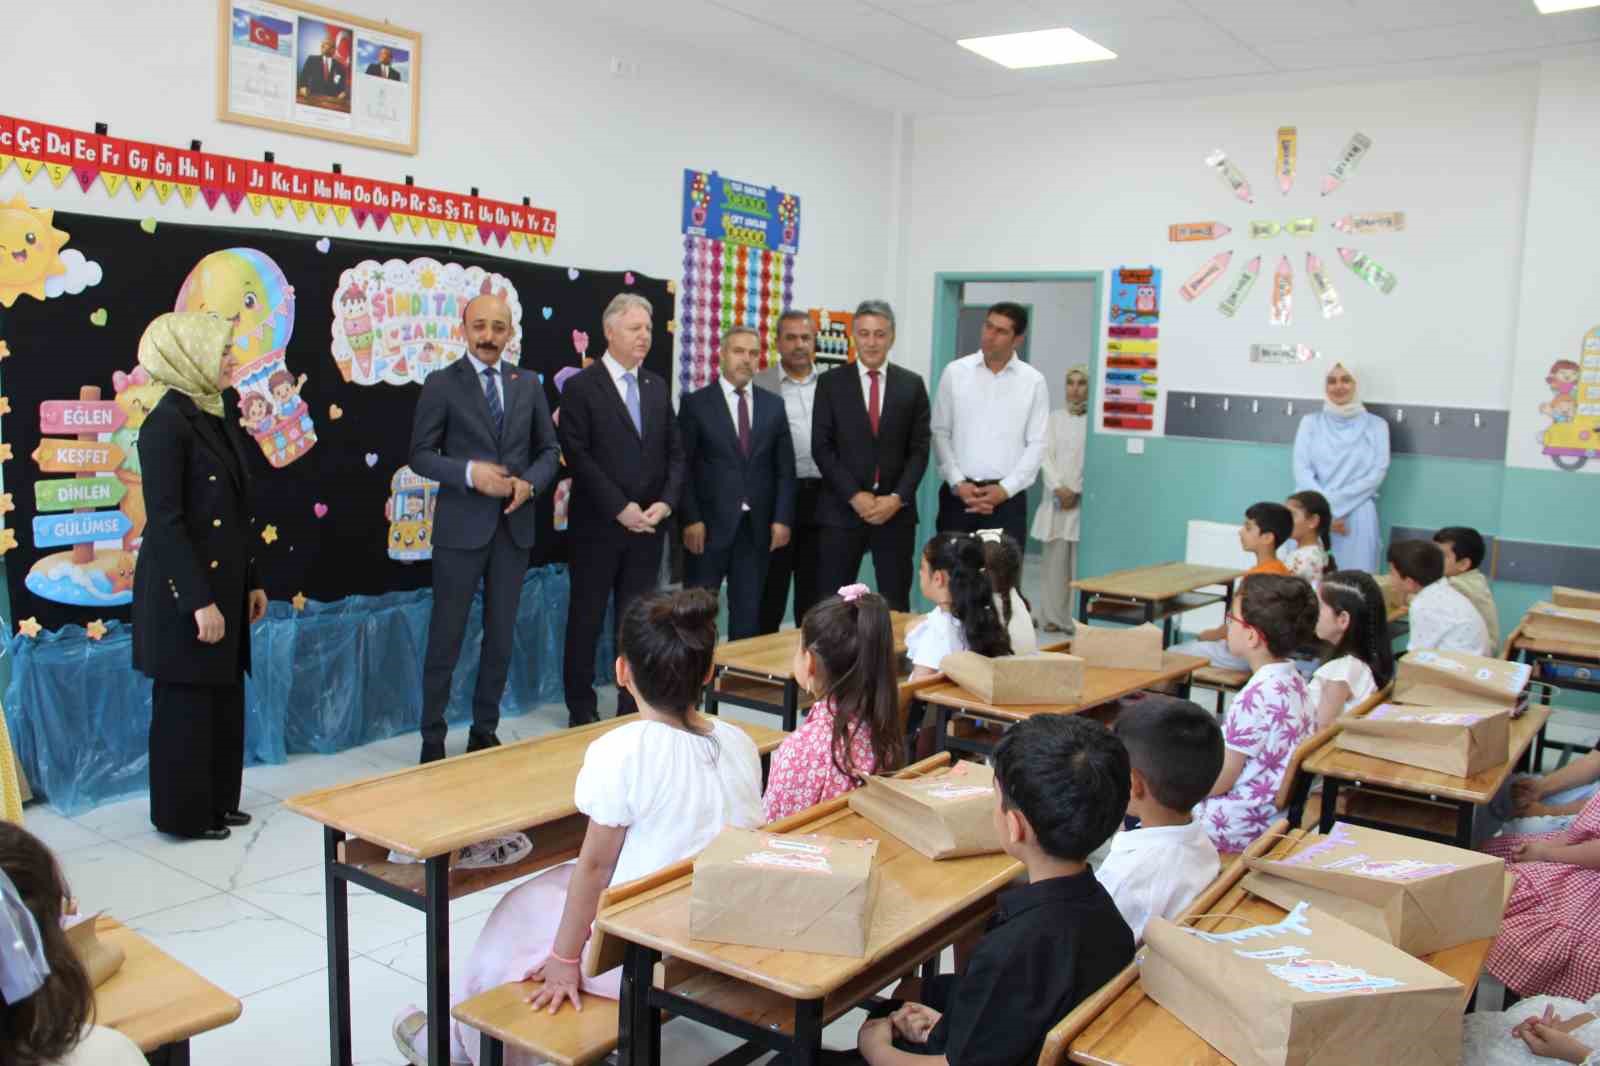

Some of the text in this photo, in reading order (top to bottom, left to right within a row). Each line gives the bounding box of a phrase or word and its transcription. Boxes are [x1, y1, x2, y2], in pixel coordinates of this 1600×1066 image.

[24, 163, 33, 175] 4
[0, 125, 13, 145] c
[16, 126, 41, 154] Çç
[46, 132, 71, 156] Dd
[75, 138, 97, 161] Ee
[101, 143, 119, 166] Ff
[128, 149, 149, 171] Gg
[178, 156, 198, 178] Hh
[271, 171, 290, 192] Kk
[353, 185, 371, 204] Oo
[391, 190, 408, 209] Pp
[410, 194, 427, 212] Rr
[427, 197, 443, 214] Ss
[542, 217, 556, 233] Zz
[63, 406, 113, 426] EĞLEN
[56, 447, 110, 467] KEŞFET
[58, 484, 111, 502] DİNLEN
[54, 518, 120, 537] GÜLÜMSE
